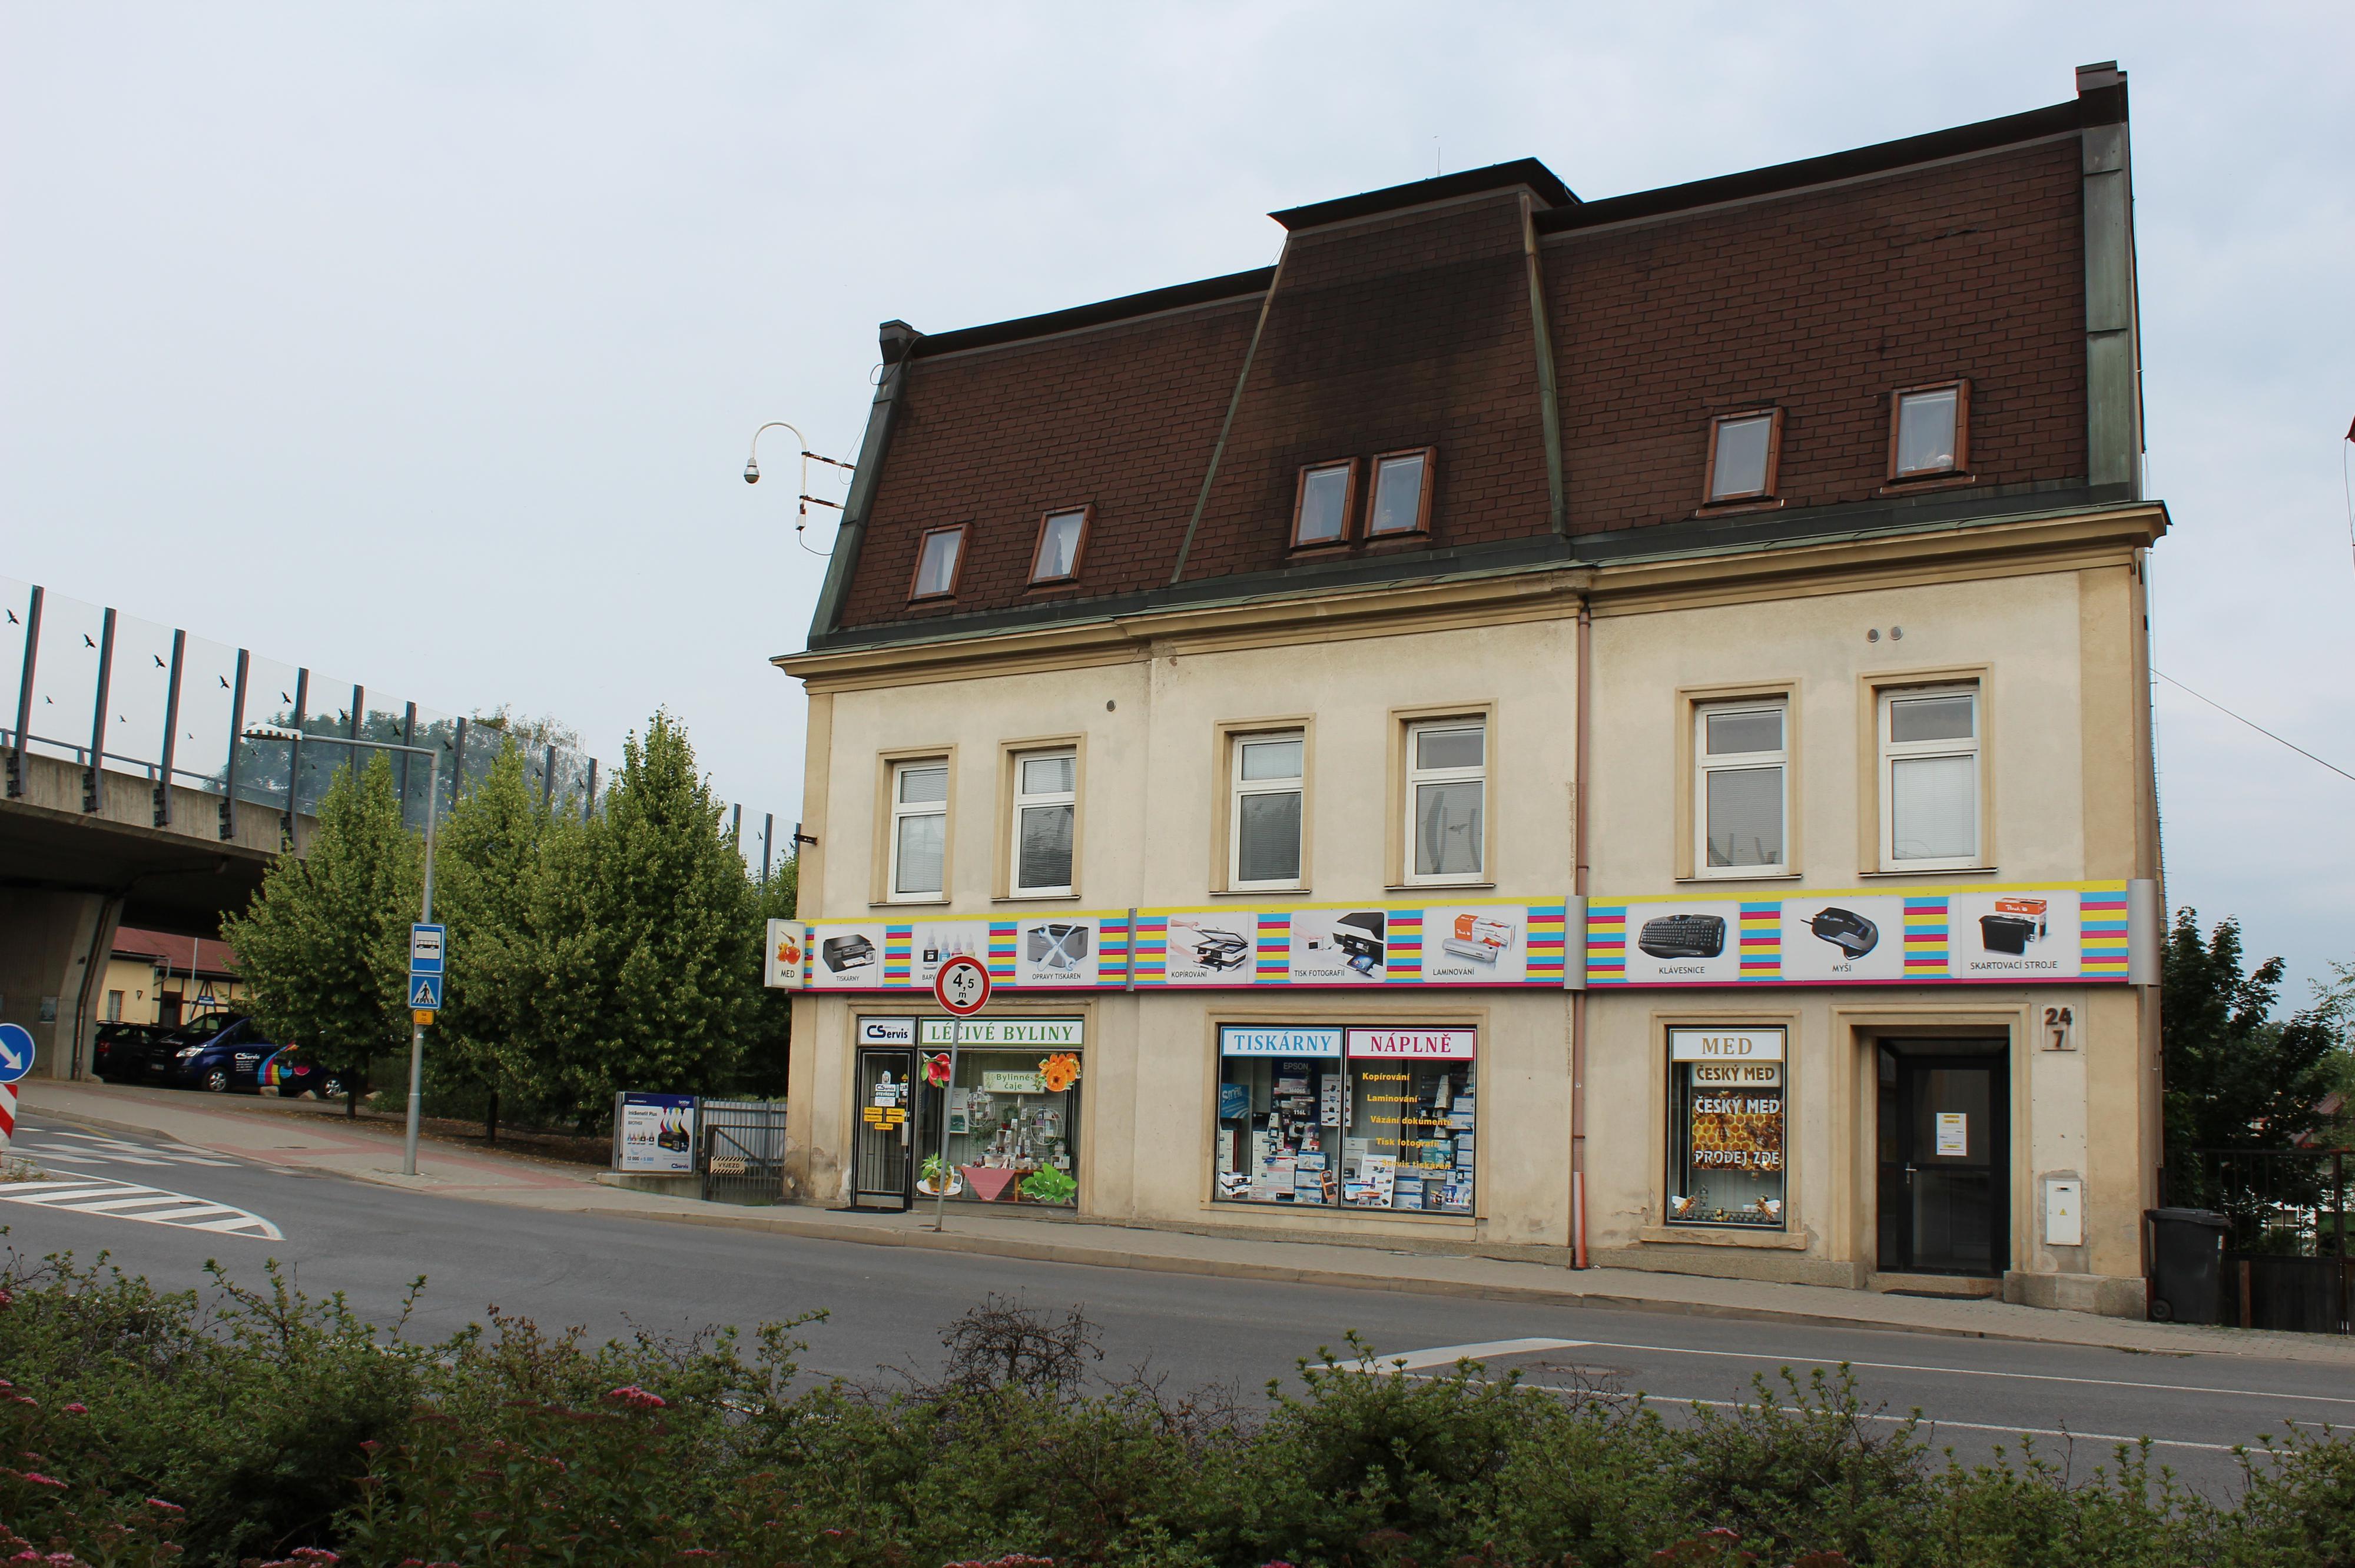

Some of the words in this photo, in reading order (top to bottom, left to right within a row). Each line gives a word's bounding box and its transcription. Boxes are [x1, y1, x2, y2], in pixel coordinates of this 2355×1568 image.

[1659, 965, 1705, 974] KLÁVESNICE
[1832, 963, 1851, 972] MYŠI
[1970, 960, 2022, 970] SKARTOVACÍ
[2025, 961, 2058, 969] STROJE
[781, 970, 795, 978] MED
[1309, 968, 1345, 976] FOTOGRAFIÍ
[1433, 966, 1475, 975] LAMINOVÁNÍ
[2045, 1008, 2072, 1025] 24
[1003, 1026, 1073, 1041] BYLINY
[2053, 1030, 2064, 1047] 7
[1234, 1031, 1332, 1051] TISKÁRNY
[1371, 1032, 1451, 1052] NÁPLNĚ
[1701, 1038, 1752, 1055] MED
[996, 1074, 1030, 1082] Bylinné
[1362, 1072, 1410, 1081] Kopírování
[1696, 1064, 1740, 1082] ČESKÝ
[1744, 1067, 1775, 1080] MED
[1367, 1094, 1418, 1102] Laminování
[1746, 1099, 1780, 1114] MED
[1402, 1117, 1453, 1126] dokumentů
[1694, 1151, 1747, 1167] PRODEJ
[1753, 1151, 1780, 1165] ZDE
[1381, 1159, 1410, 1168] Servis
[1412, 1160, 1451, 1170] tiskáren
